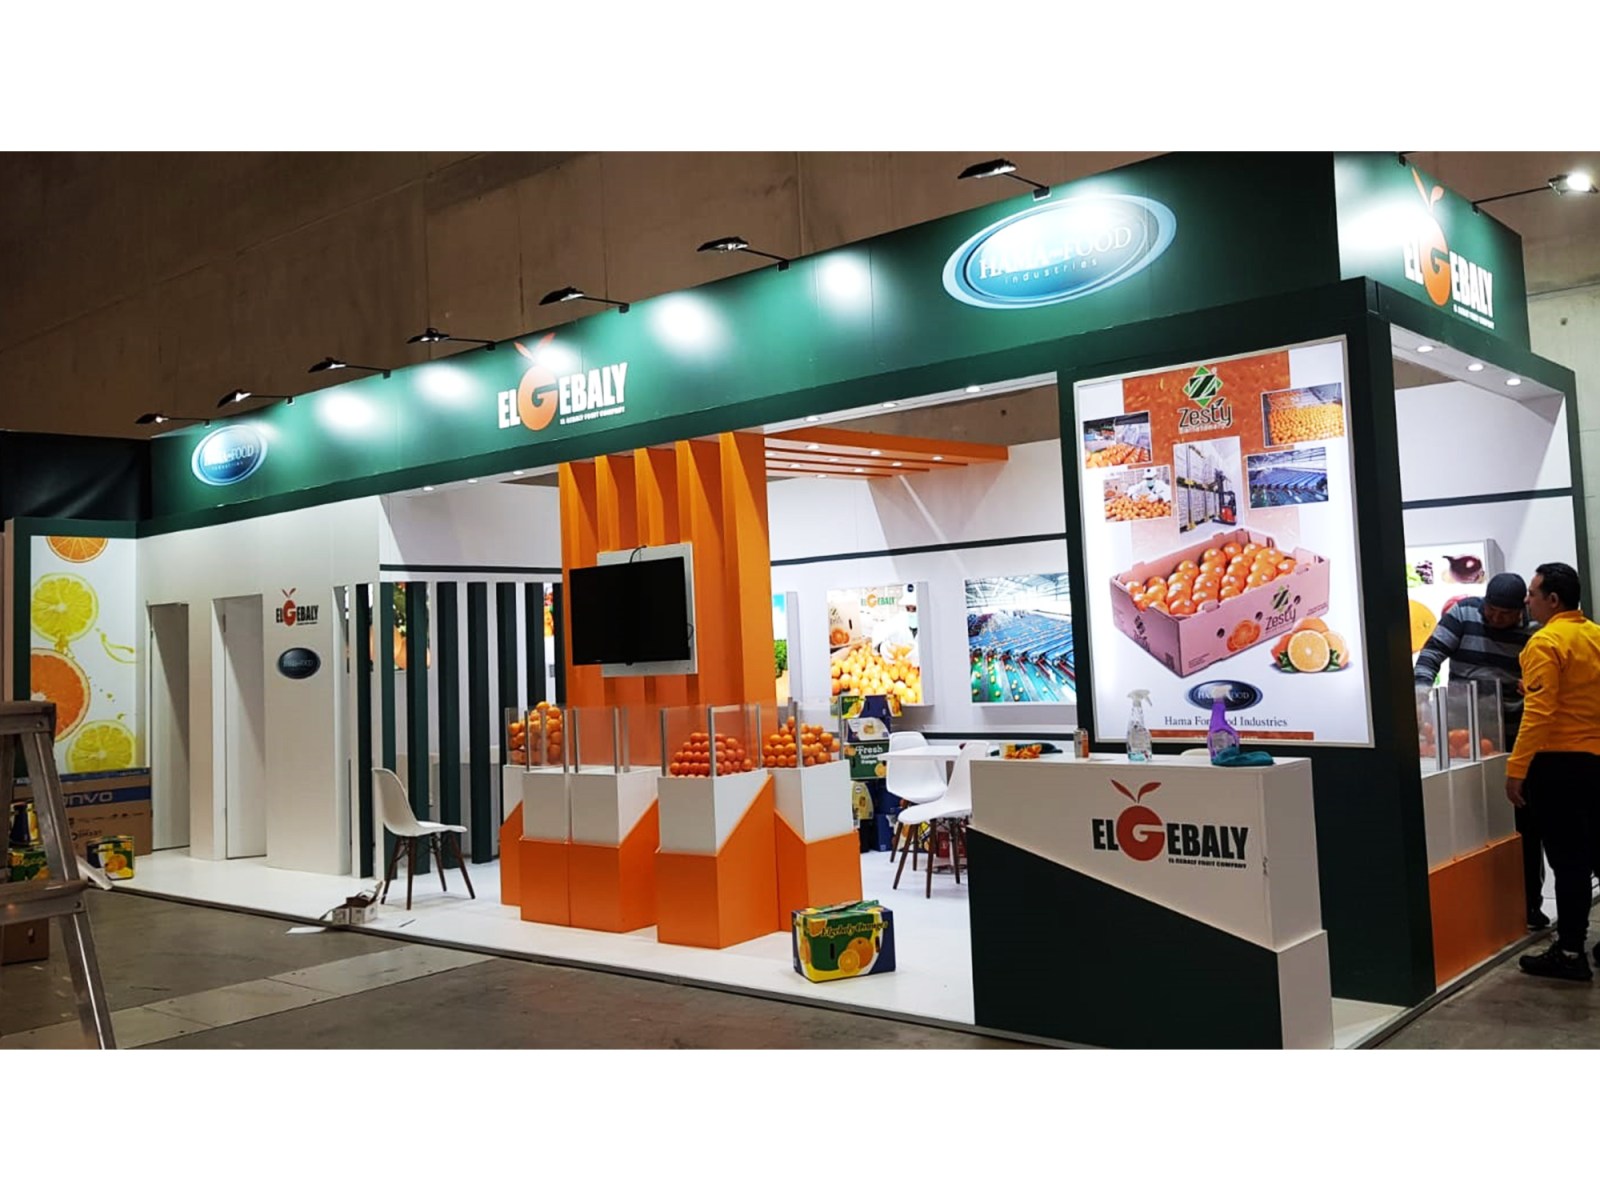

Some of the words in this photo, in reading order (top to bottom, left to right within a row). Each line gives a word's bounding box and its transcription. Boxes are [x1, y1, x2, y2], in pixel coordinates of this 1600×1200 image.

[1178, 398, 1232, 427] Zesty
[1164, 716, 1192, 726] Hama
[1240, 716, 1288, 727] Industries
